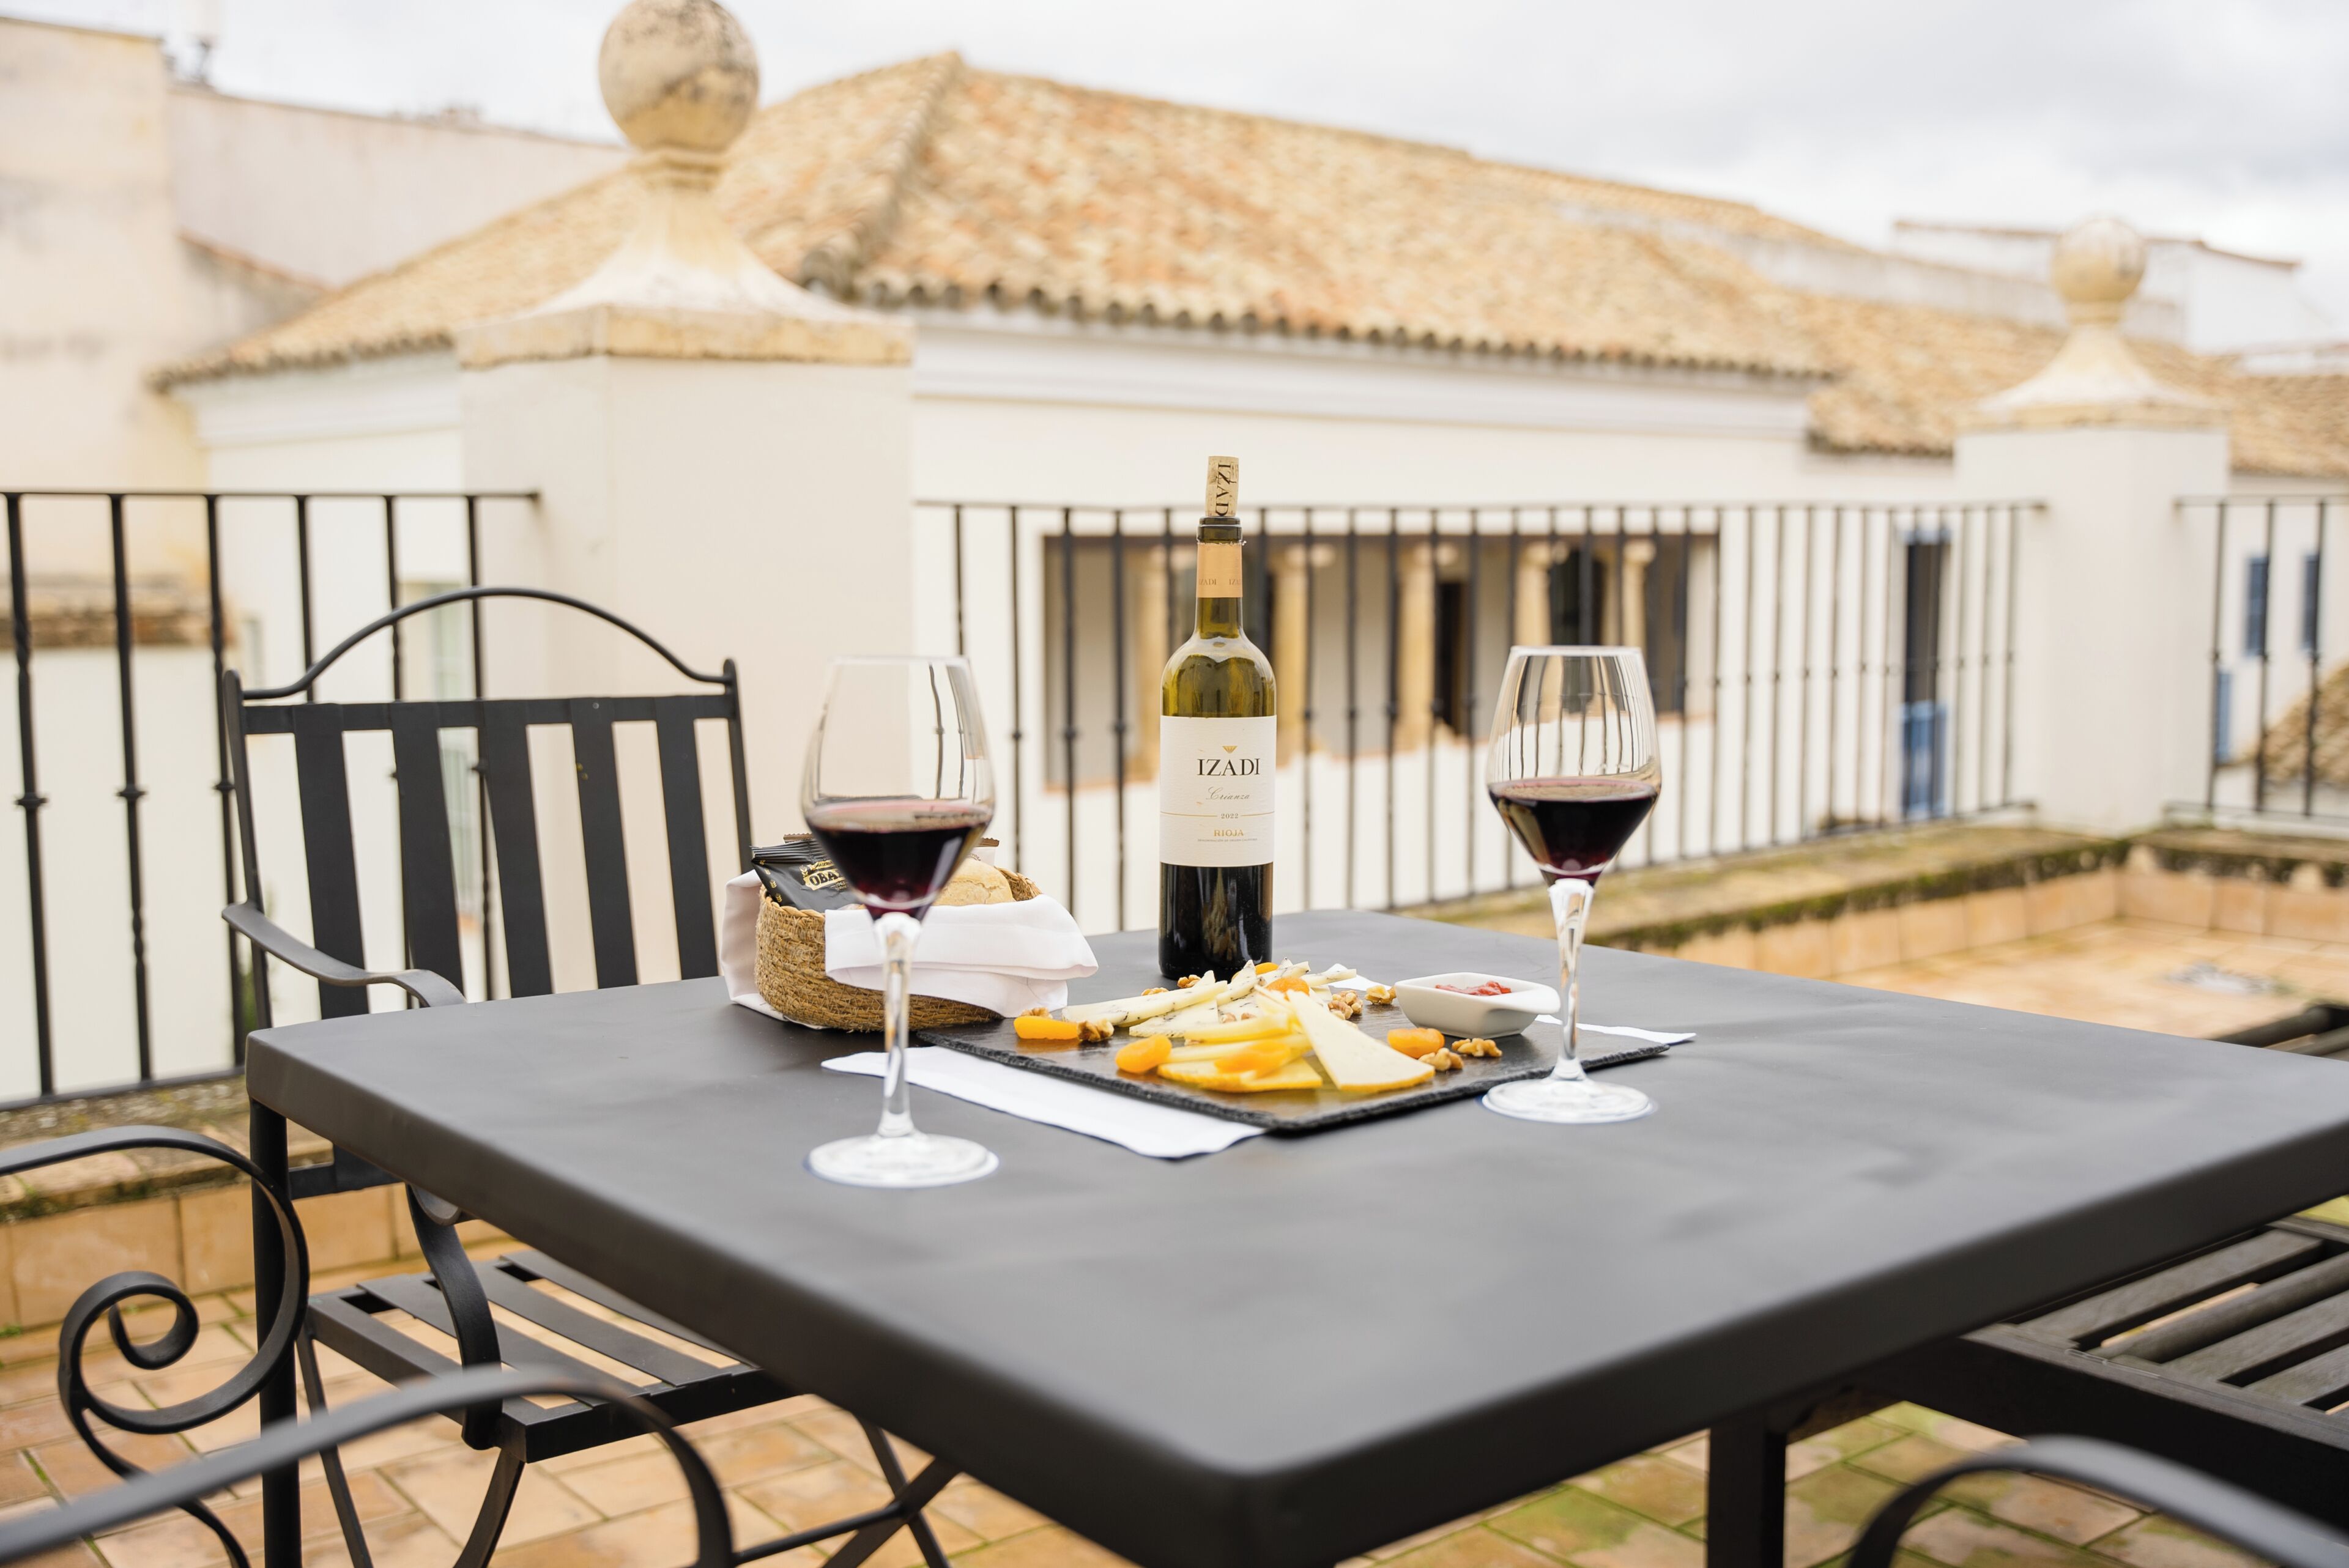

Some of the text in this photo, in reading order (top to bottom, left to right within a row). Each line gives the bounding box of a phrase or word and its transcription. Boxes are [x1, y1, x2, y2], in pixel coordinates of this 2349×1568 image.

[1215, 464, 1231, 516] IZAD
[1197, 758, 1261, 776] IZADI
[1205, 786, 1250, 800] Crianza
